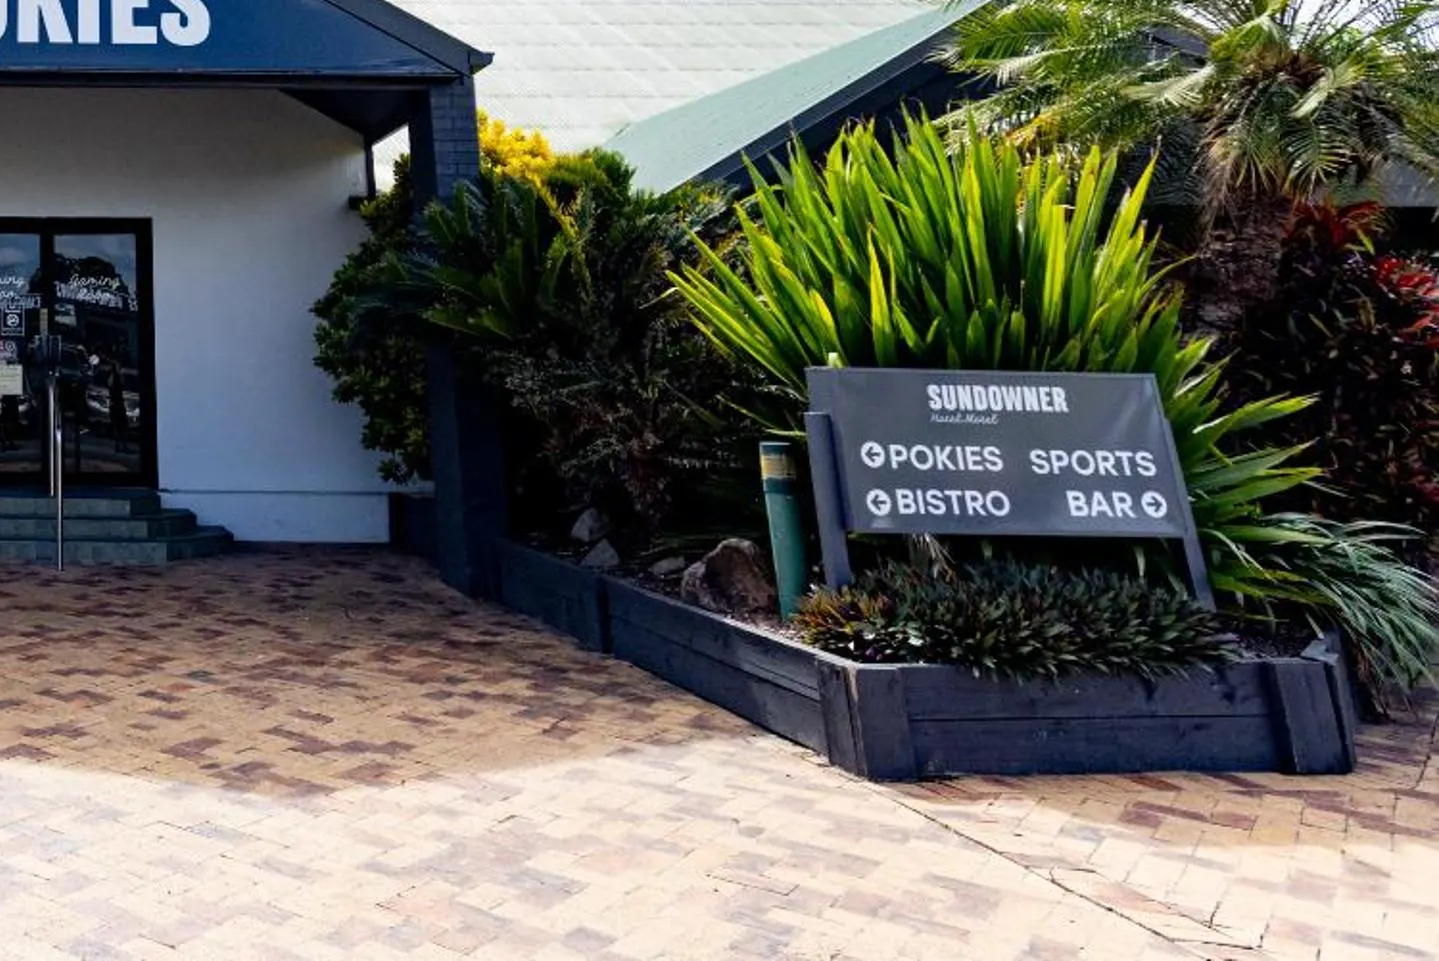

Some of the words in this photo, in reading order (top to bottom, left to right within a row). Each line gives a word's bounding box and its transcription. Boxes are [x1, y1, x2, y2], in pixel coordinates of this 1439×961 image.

[927, 384, 1069, 413] SUNDOWNER
[890, 444, 1004, 472] POKIES
[1030, 449, 1157, 477] SPORTS
[896, 488, 1011, 517] BISTRO
[1066, 490, 1137, 518] BAR
